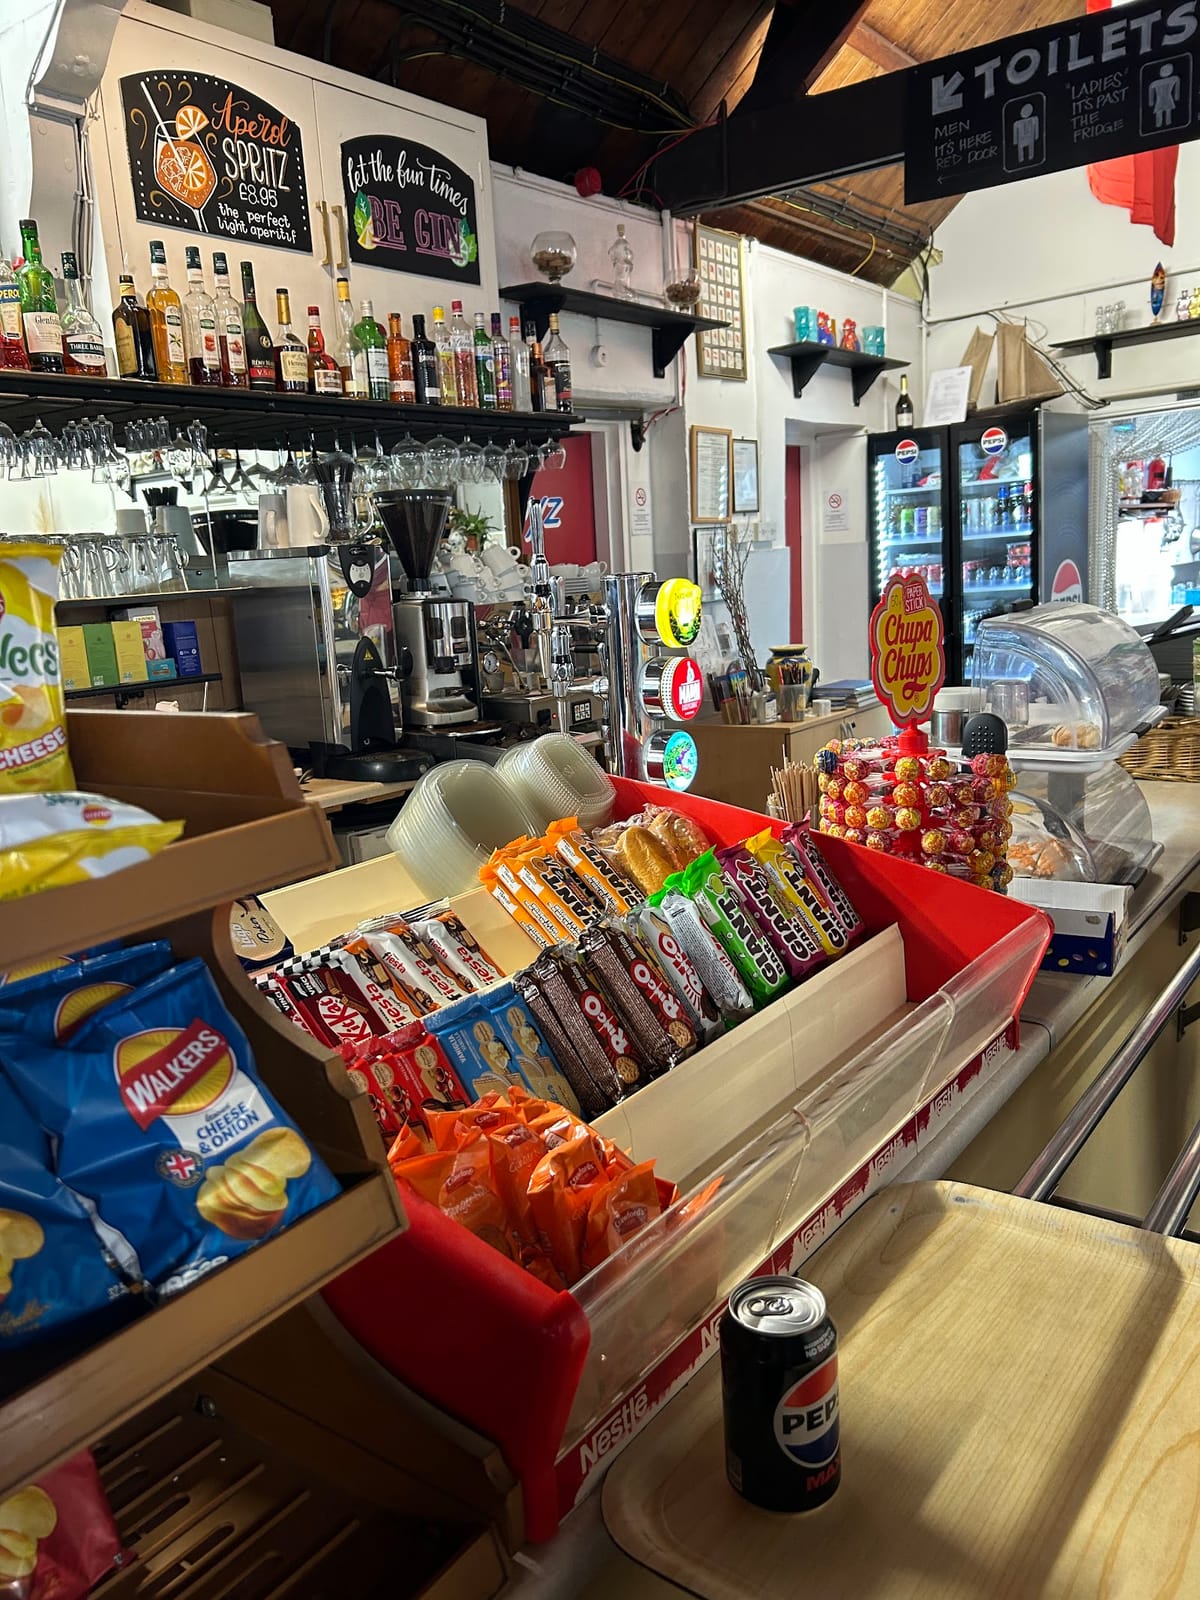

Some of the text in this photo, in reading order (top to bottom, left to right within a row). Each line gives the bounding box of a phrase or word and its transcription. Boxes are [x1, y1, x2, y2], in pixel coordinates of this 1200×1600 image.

[974, 1, 1199, 99] TOILETS
[1097, 87, 1129, 108] PAST
[211, 91, 291, 147] Aperol
[934, 120, 971, 140] MEN
[1071, 112, 1100, 130] THE
[1073, 119, 1125, 143] FRIDGE
[936, 146, 998, 170] RED DOOR
[959, 131, 992, 152] HERE
[222, 137, 291, 191] SPRITZ
[347, 149, 468, 215] let the fun times
[239, 183, 278, 207] £8.95
[217, 216, 297, 244] light aperitif
[218, 203, 291, 228] the perfect
[367, 195, 462, 256] BE GIN
[897, 448, 917, 457] PEPSI
[983, 437, 1004, 446] PEPSI
[905, 584, 923, 599] PAPER
[905, 597, 924, 612] STICK
[884, 614, 933, 652] Chupa
[884, 647, 933, 684] Chups
[744, 878, 812, 960] GIANT
[784, 869, 847, 949] GIANT
[427, 938, 448, 960] fiesta
[716, 896, 781, 985] GIANT
[382, 952, 407, 974] fiesta
[415, 959, 463, 1002] fiesta
[300, 975, 316, 996] VINCI
[633, 963, 680, 1019] RINGO
[319, 997, 372, 1043] KitKat
[584, 994, 629, 1055] RINGO
[125, 1029, 220, 1114] WALKERS
[196, 1101, 249, 1140] CHEESE
[199, 1141, 212, 1155] &
[211, 1110, 260, 1148] ONION
[782, 1389, 839, 1435] PEP
